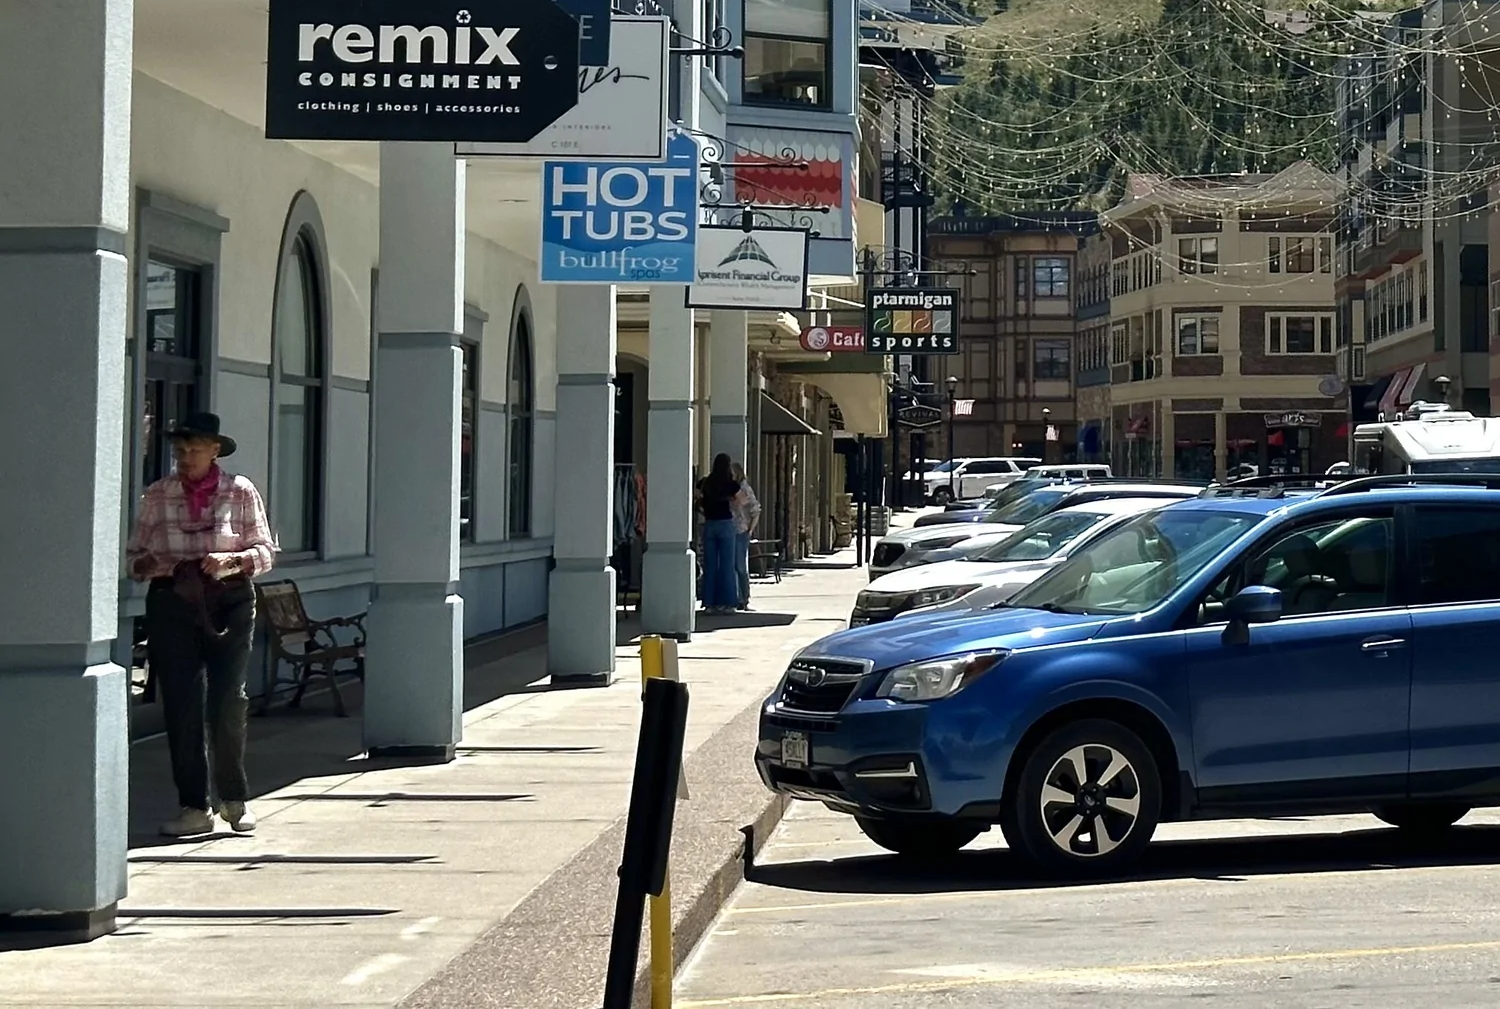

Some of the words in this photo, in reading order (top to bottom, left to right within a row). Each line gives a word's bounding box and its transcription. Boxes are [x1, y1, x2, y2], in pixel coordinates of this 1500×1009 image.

[298, 9, 521, 66] remix
[298, 72, 521, 89] CONSIGNMENT
[298, 101, 360, 113] clothing
[377, 102, 419, 112] shoes
[435, 103, 521, 113] accessories
[552, 166, 690, 207] HOT
[551, 210, 689, 241] TUBS
[559, 247, 682, 276] bullfrog
[630, 267, 661, 279] spas
[732, 270, 769, 281] Financial
[771, 272, 801, 284] Group
[873, 292, 952, 308] ptarmigan
[872, 336, 951, 350] sports
